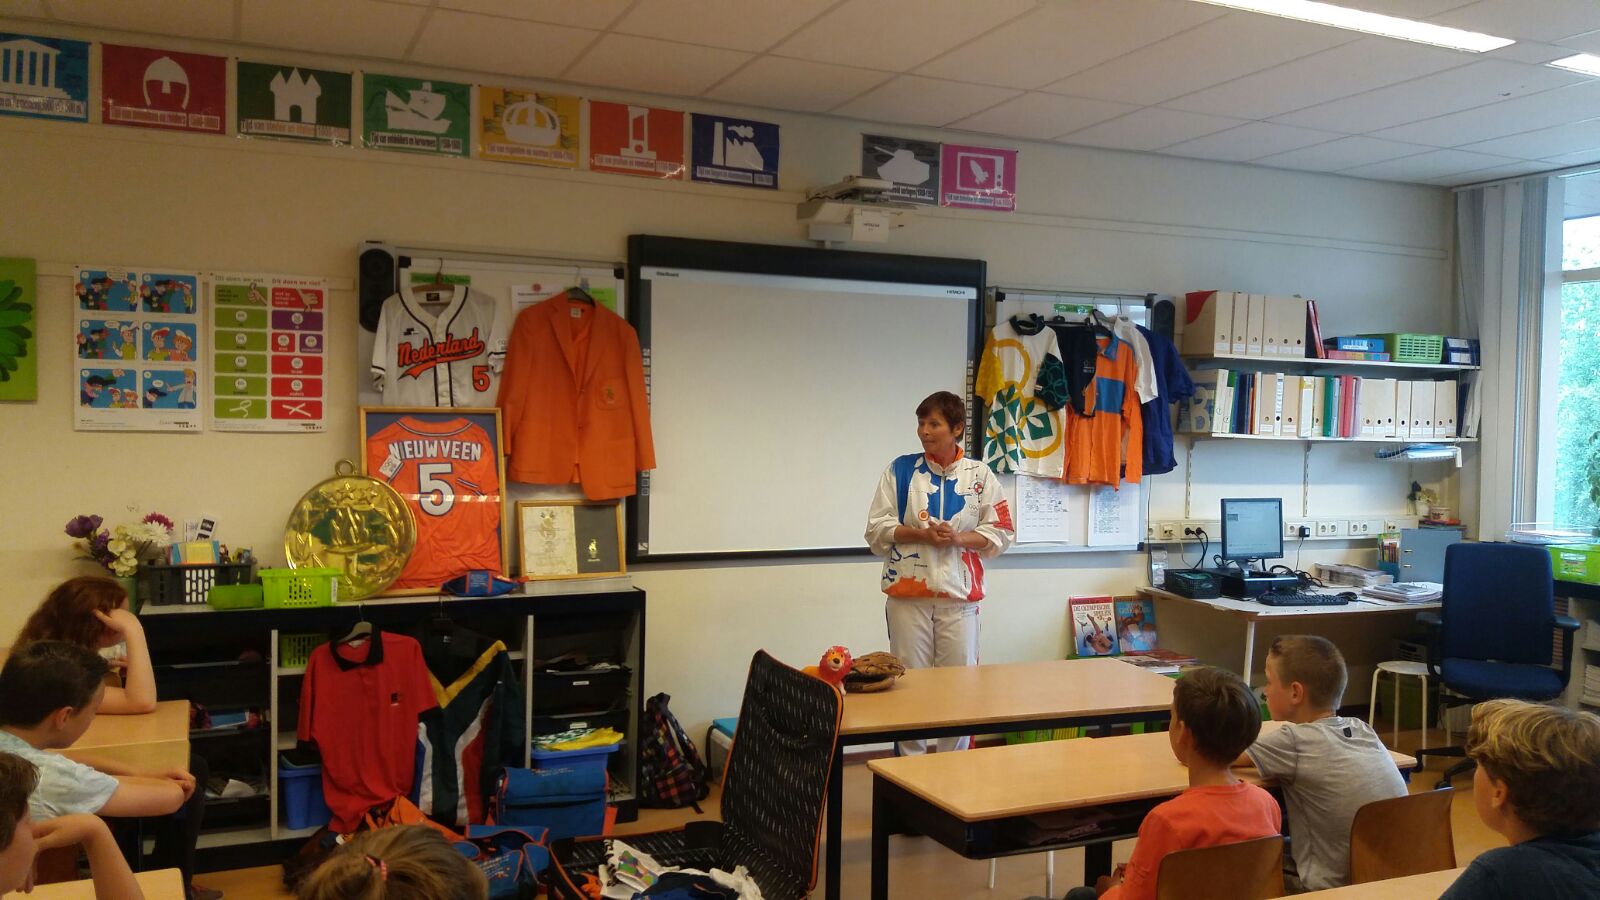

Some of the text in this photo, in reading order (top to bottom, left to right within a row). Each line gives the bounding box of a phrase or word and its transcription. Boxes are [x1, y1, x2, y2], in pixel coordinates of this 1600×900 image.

[397, 327, 485, 368] Nederland
[472, 365, 490, 392] 5
[388, 439, 482, 462] NIEUWVEEN
[418, 462, 454, 517] 5
